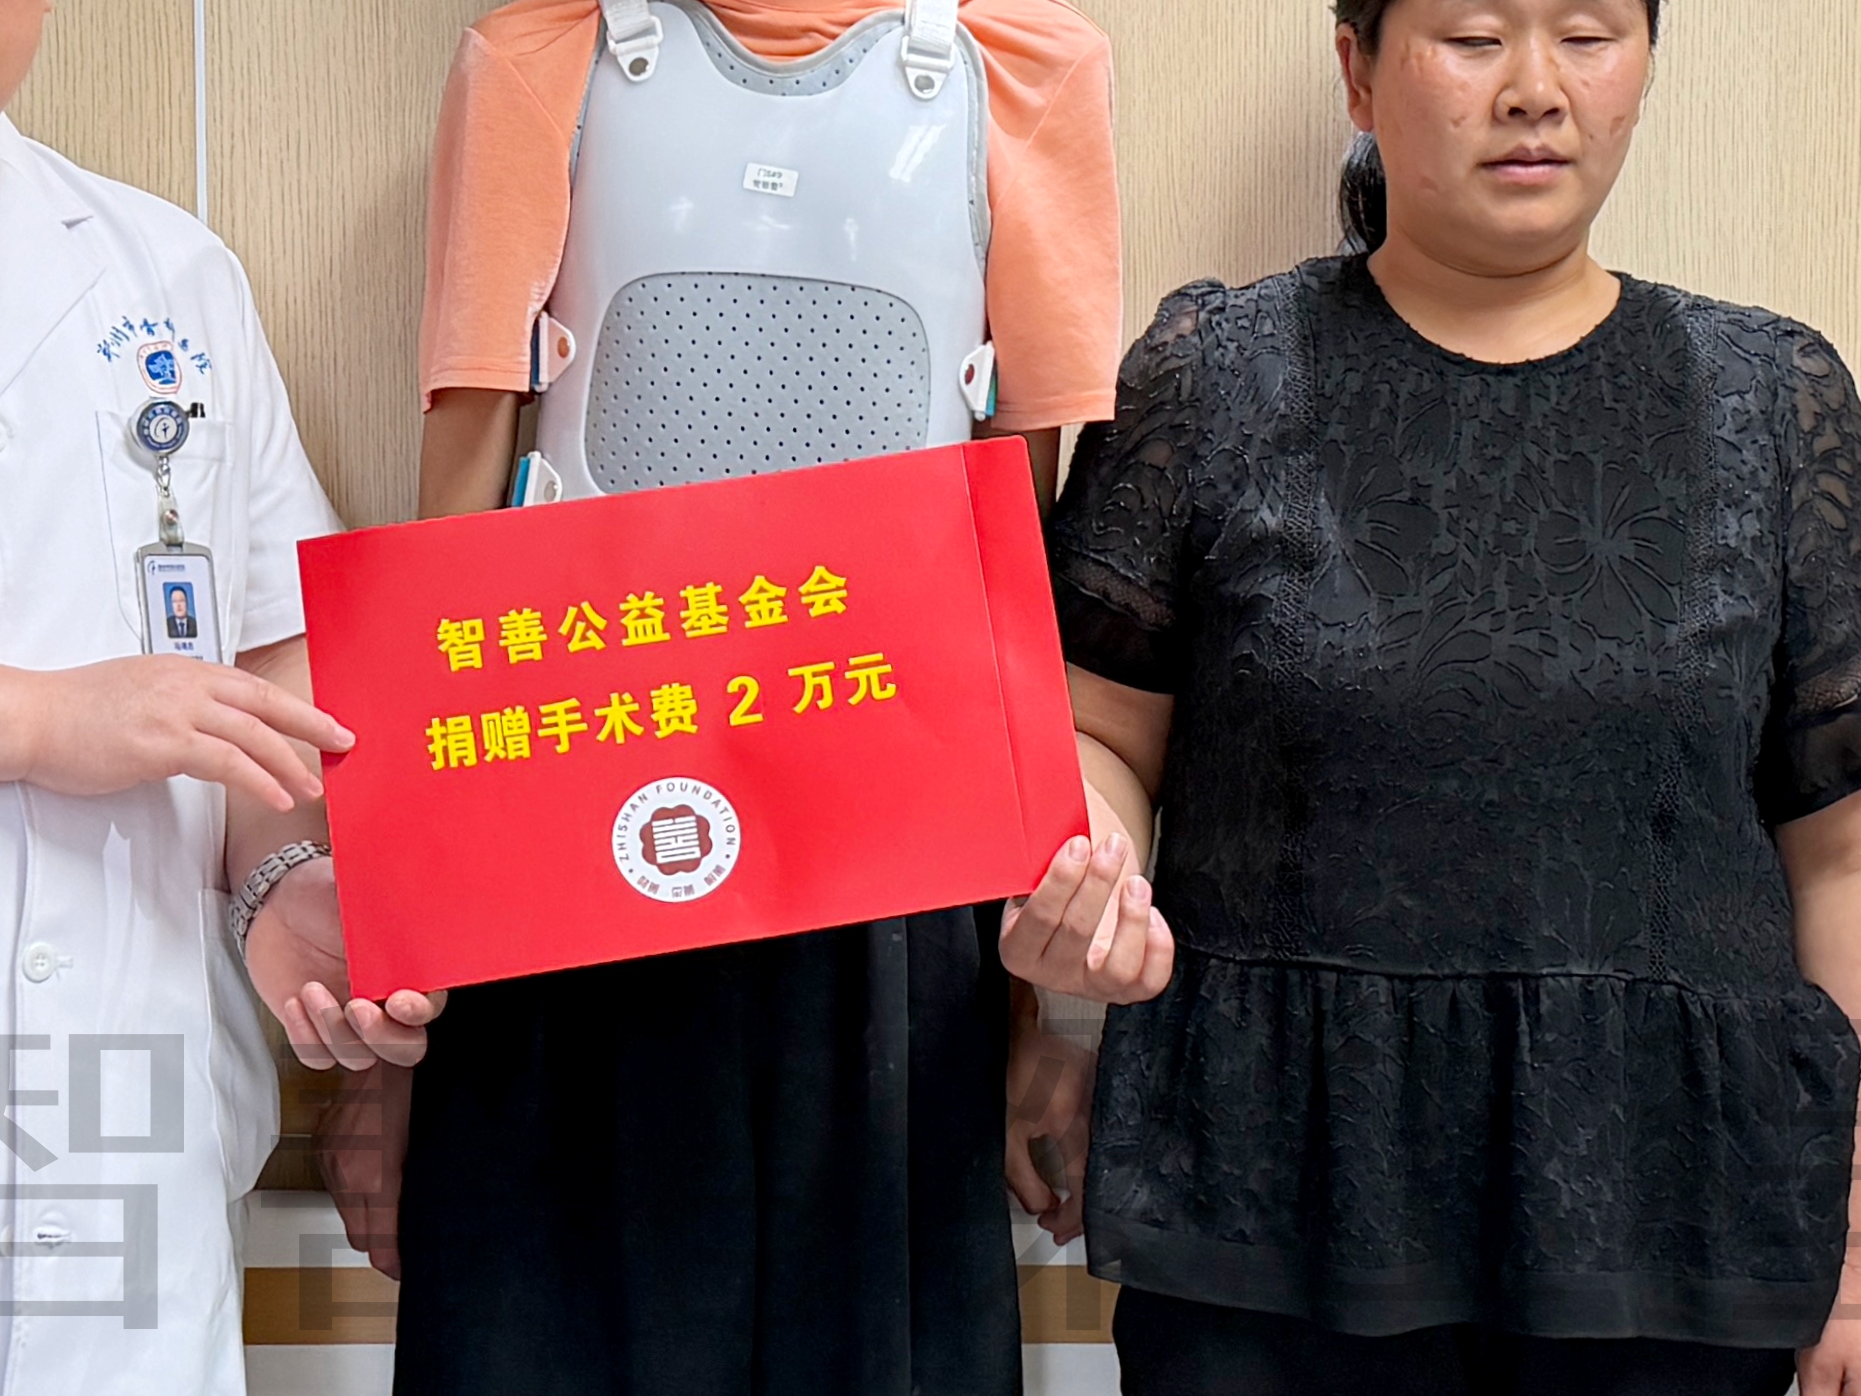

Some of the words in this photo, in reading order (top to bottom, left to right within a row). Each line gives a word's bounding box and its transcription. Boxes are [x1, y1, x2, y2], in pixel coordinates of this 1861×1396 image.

[437, 565, 850, 674] 智善公益基金会
[425, 682, 700, 772] 捐赠手术费
[726, 676, 765, 729] 2
[788, 651, 898, 717] 万元
[616, 792, 649, 864] ZHISHAN
[655, 781, 737, 846] FOUNDATION
